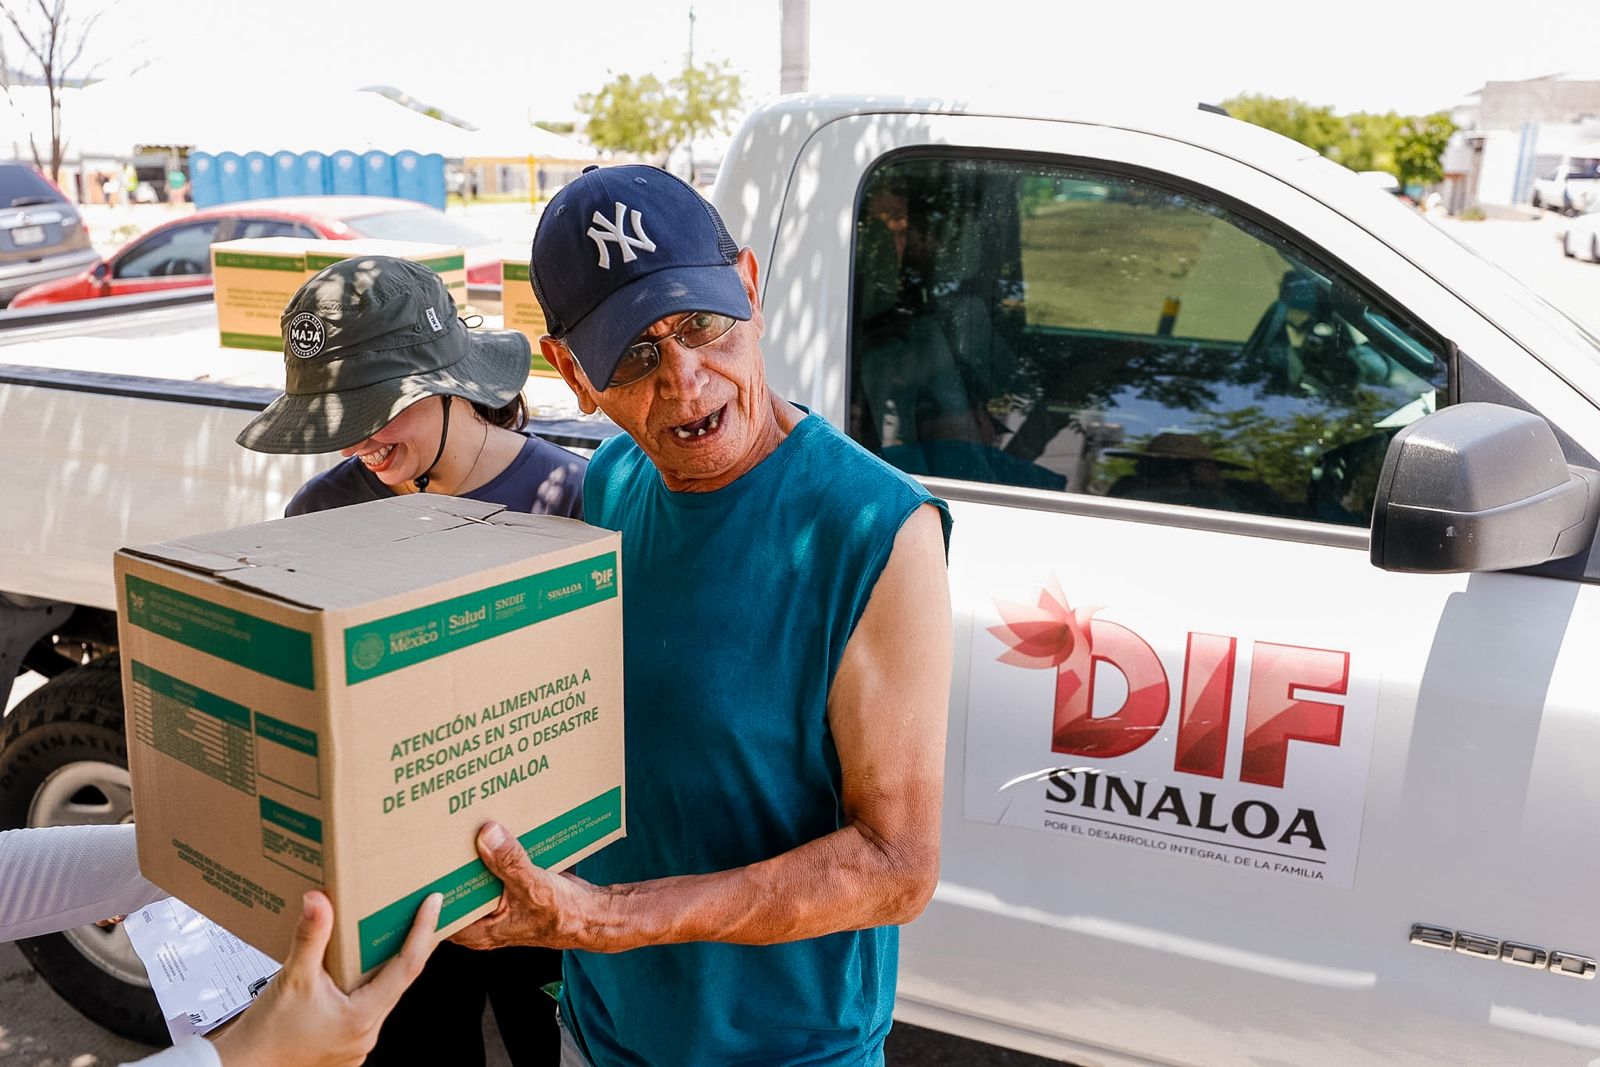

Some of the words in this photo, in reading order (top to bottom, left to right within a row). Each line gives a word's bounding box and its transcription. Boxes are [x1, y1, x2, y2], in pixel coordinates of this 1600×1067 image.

[586, 201, 656, 270] NY
[291, 328, 320, 342] MAJA
[495, 592, 525, 609] SNDIF
[547, 583, 582, 600] SINALOA
[594, 568, 613, 586] DIF
[390, 630, 438, 655] México
[448, 605, 486, 629] Salud
[391, 712, 477, 761] ATENCIÓN
[481, 673, 578, 724] ALIMENTARIA
[582, 668, 591, 682] A
[1051, 617, 1350, 789] DIF
[383, 790, 405, 814] DE
[411, 744, 514, 802] EMERGENCIA
[518, 737, 528, 753] O
[533, 706, 599, 746] DESASTRE
[395, 735, 480, 784] PERSONAS
[485, 725, 505, 745] EN
[510, 691, 586, 735] SITUACIÓN
[449, 787, 477, 815] DIF
[481, 754, 549, 799] SINALOA
[1045, 766, 1327, 851] SINALOA
[1044, 819, 1068, 832] POR
[1071, 824, 1084, 835] EL
[1087, 827, 1168, 850] DESARROLLO
[1170, 843, 1231, 865] INTEGRAL
[1234, 855, 1251, 867] DE
[1254, 859, 1271, 870] LA
[1273, 862, 1325, 881] FAMILIA
[1409, 922, 1597, 980] 2500
